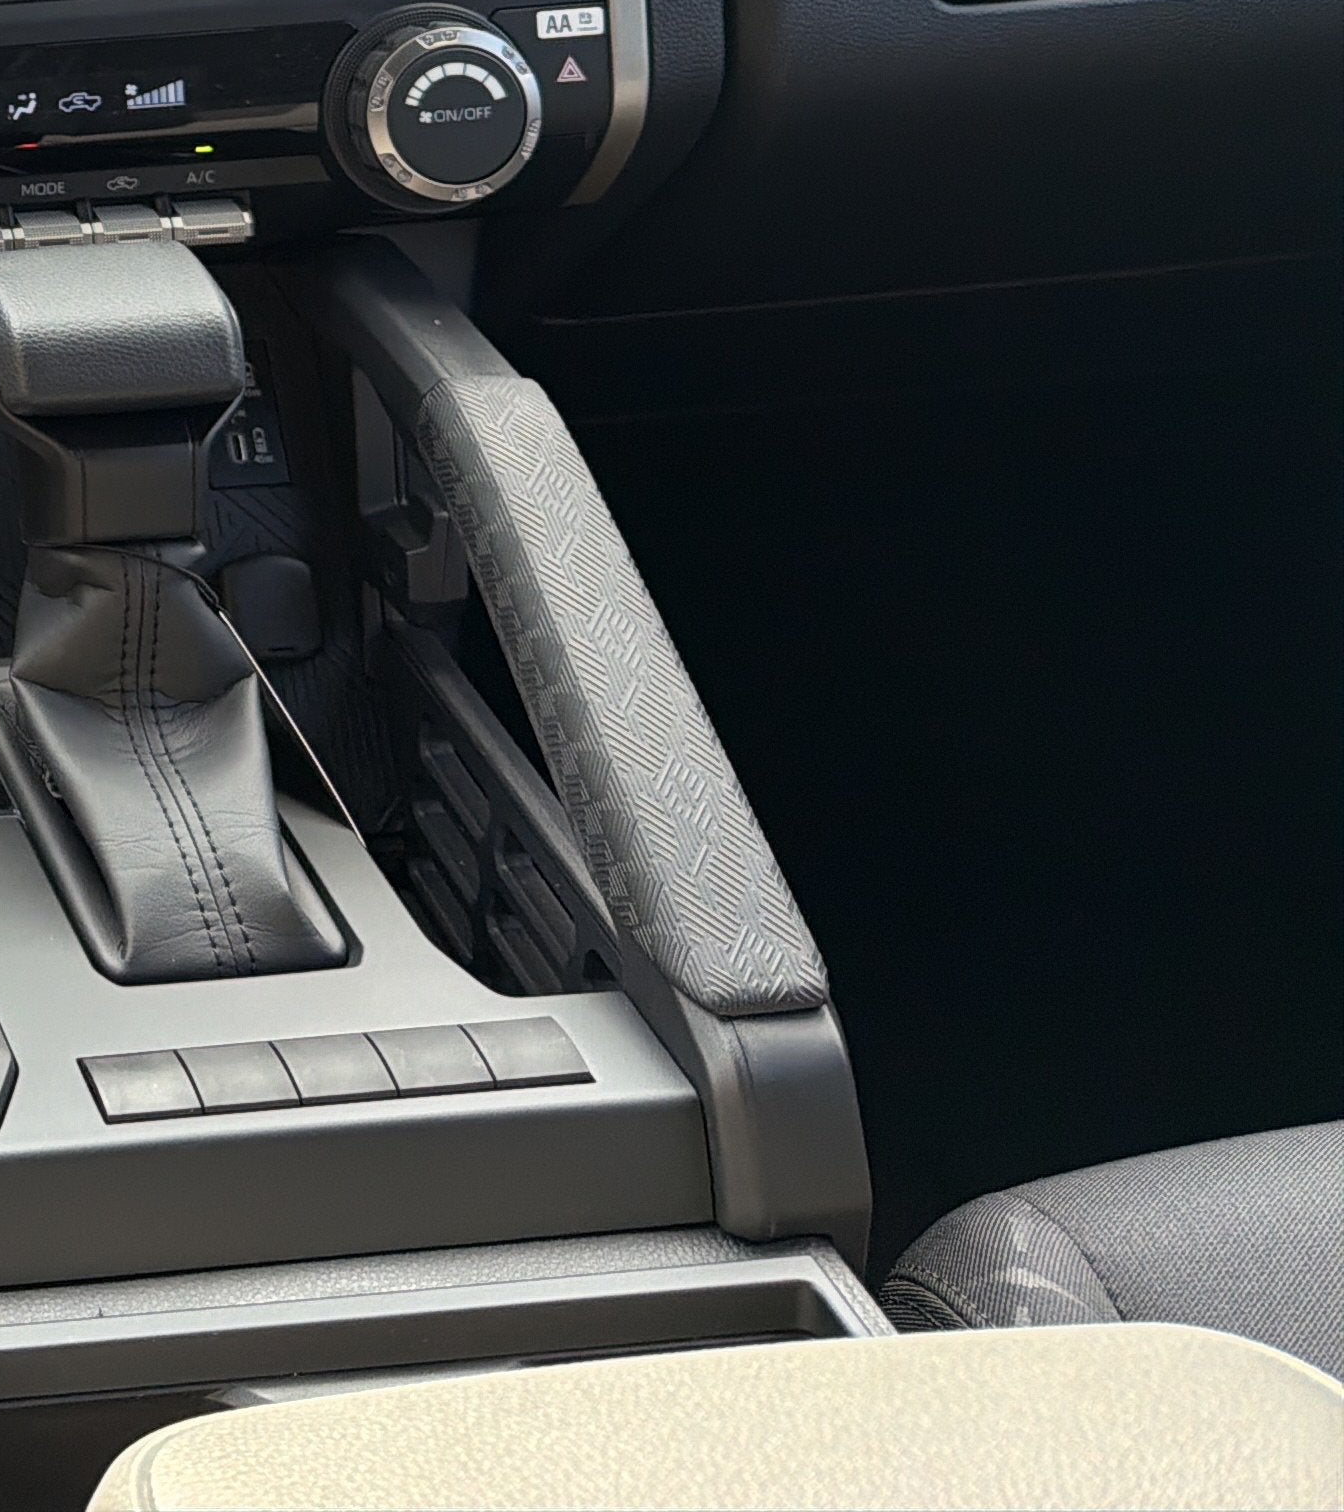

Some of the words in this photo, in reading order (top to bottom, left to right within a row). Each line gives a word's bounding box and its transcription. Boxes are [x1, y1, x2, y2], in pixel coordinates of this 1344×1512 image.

[546, 13, 572, 34] AA
[433, 106, 492, 123] ON/OFF
[186, 170, 216, 185] A/C
[21, 181, 66, 197] MODE
